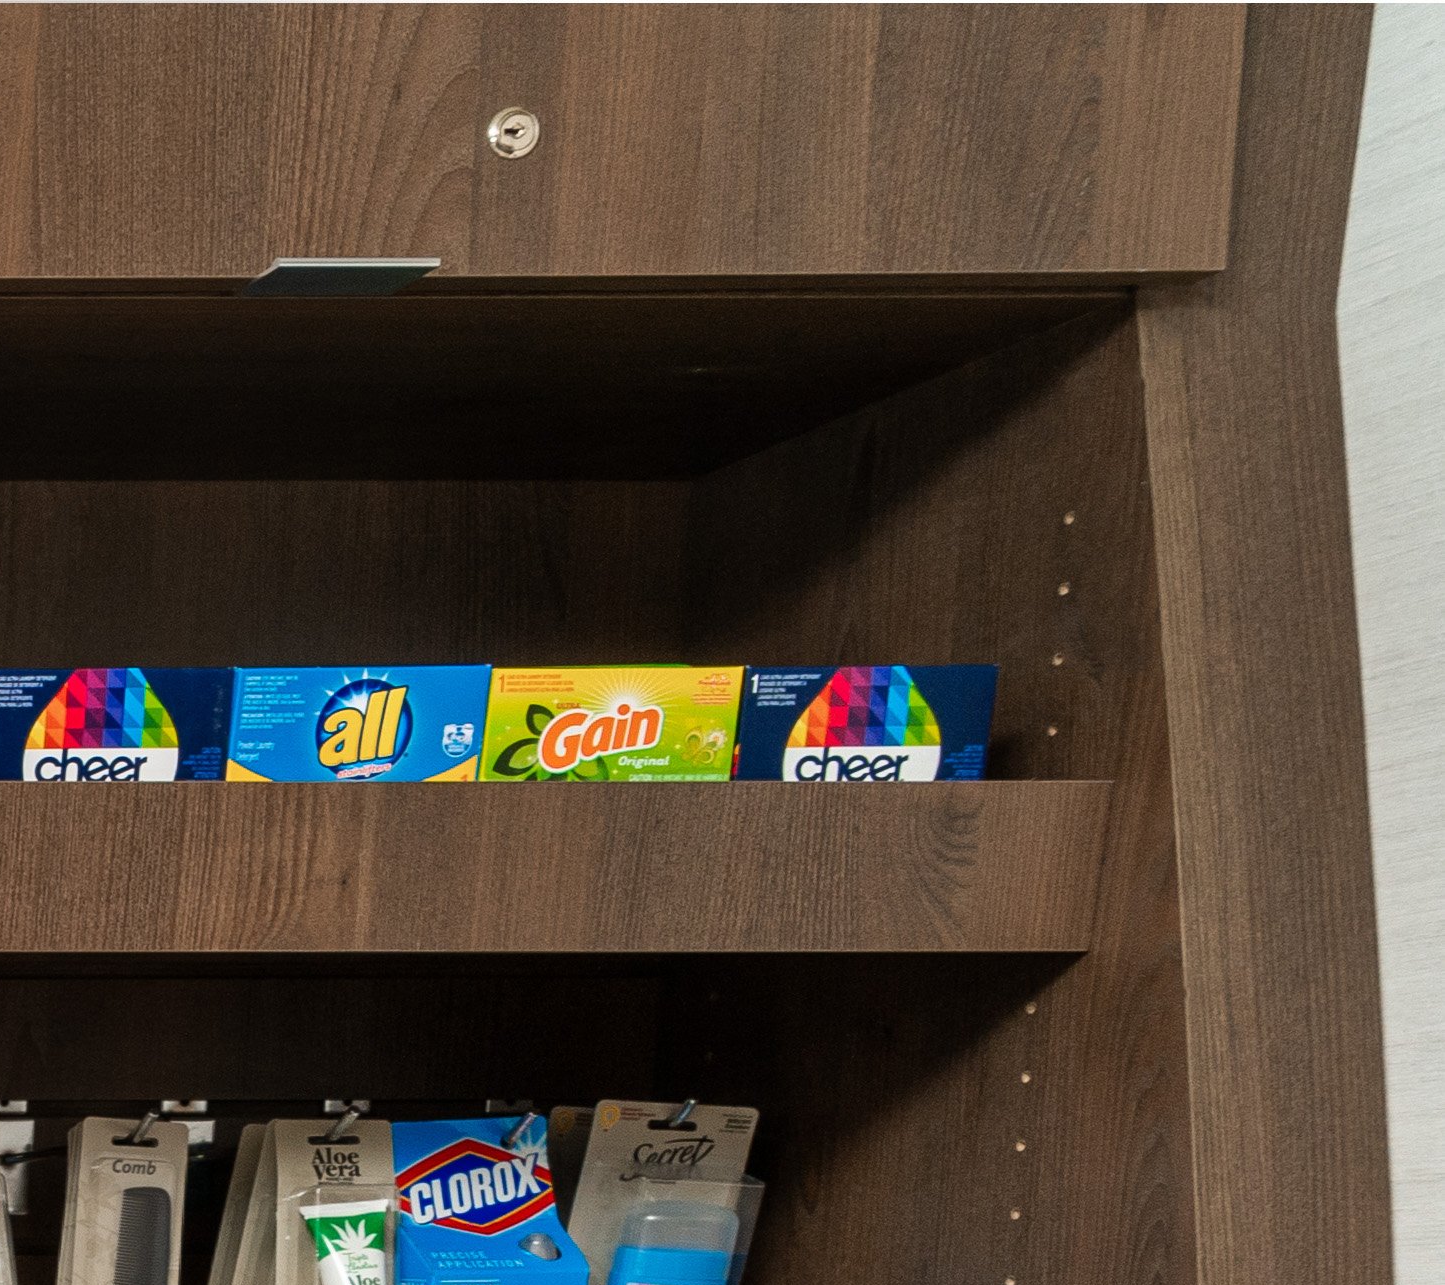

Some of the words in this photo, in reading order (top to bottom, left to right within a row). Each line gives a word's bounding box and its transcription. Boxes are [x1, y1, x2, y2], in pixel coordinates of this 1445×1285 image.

[320, 684, 409, 770] all
[539, 704, 662, 770] Gain
[113, 1158, 157, 1178] Comb
[409, 1159, 541, 1225] CLOROX
